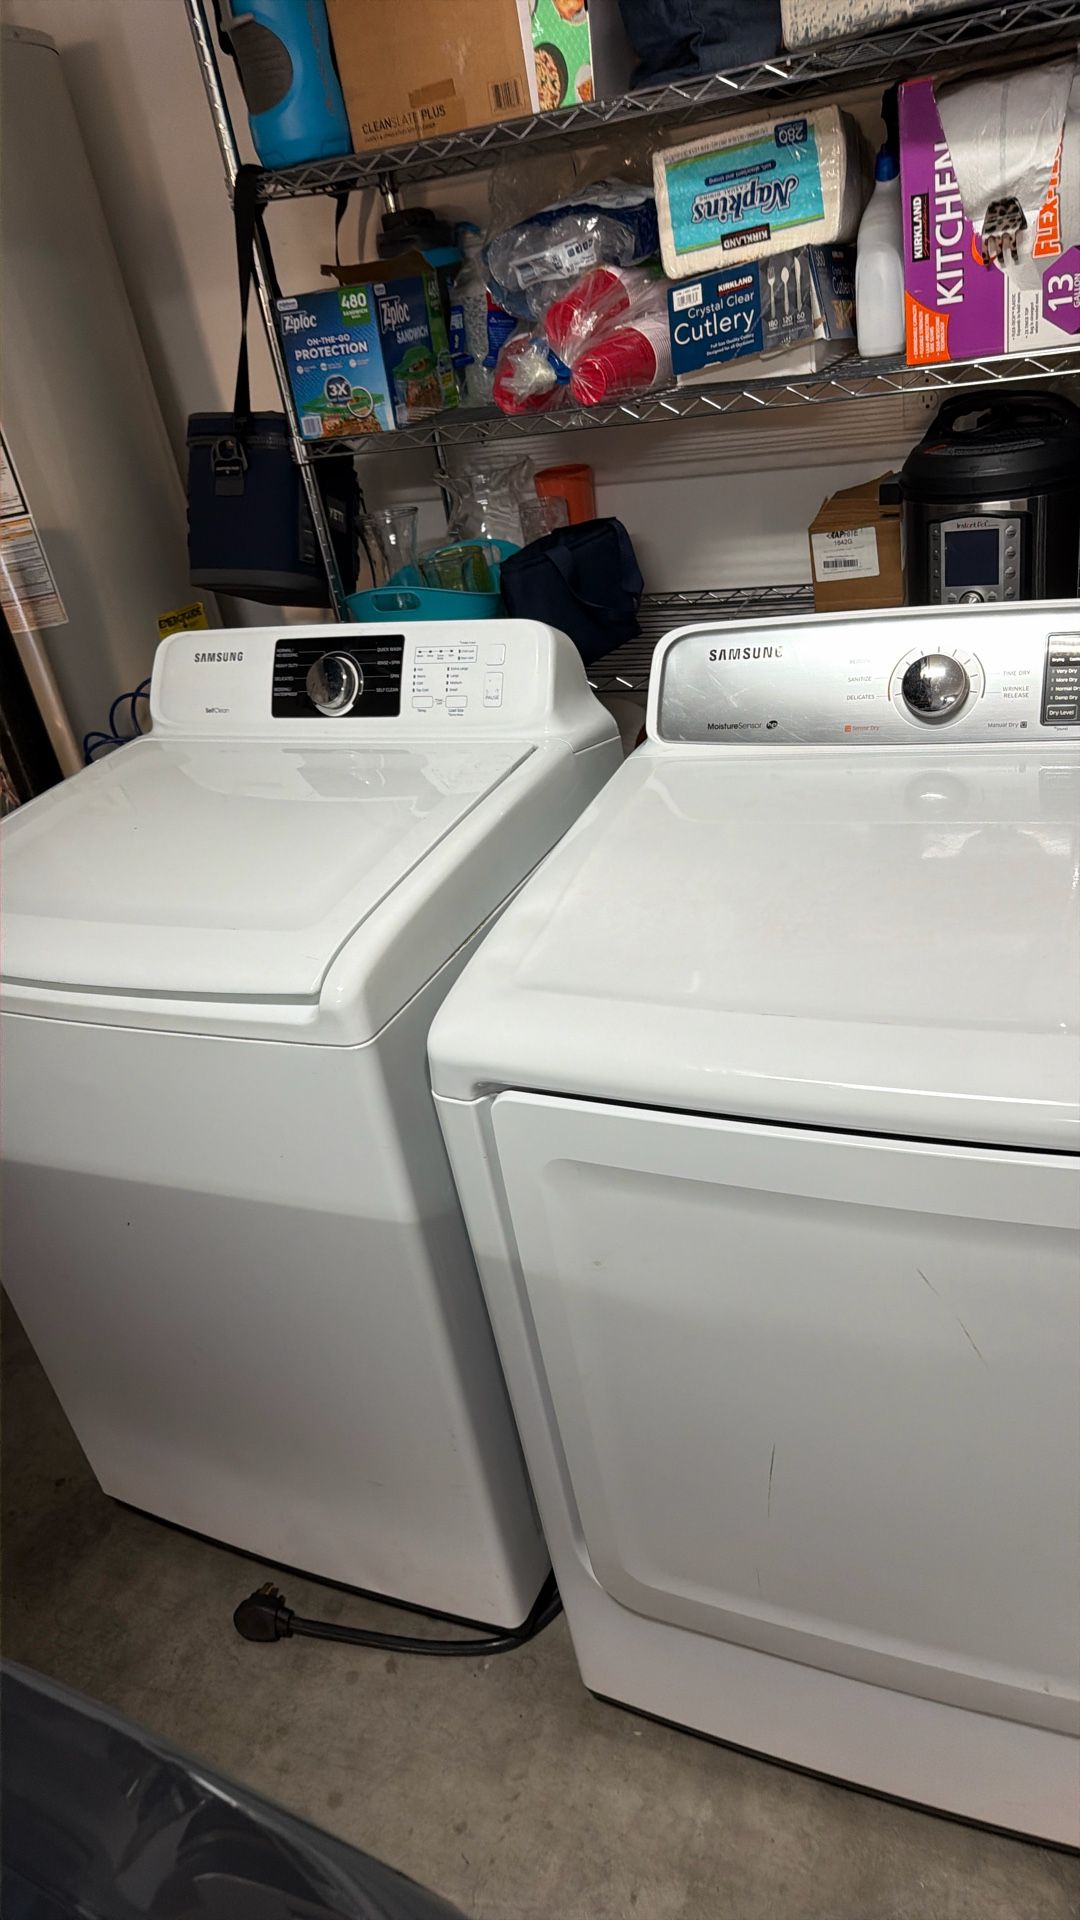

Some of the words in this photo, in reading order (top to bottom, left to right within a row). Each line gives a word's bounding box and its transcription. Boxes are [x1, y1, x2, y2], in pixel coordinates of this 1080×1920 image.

[361, 111, 419, 135] CLEANSLATE
[421, 104, 446, 121] PLUS
[778, 129, 804, 144] 280
[693, 176, 798, 223] Napkins
[912, 196, 923, 260] KIRKLAND
[934, 142, 964, 306] KITCHEN
[724, 230, 769, 249] KIRKLAND
[717, 275, 753, 292] KIRKLAND
[1047, 273, 1074, 312] 13
[341, 293, 367, 309] 480
[688, 298, 724, 319] Crystal
[726, 292, 754, 307] Clear
[283, 313, 318, 334] Ziploc
[381, 300, 411, 332] Ziploc
[767, 319, 778, 328] 180
[782, 314, 793, 324] 120
[796, 311, 805, 320] 60
[396, 325, 429, 344] SANDWICH
[674, 309, 755, 345] Cutlery
[306, 334, 351, 347] ON-THE-GO
[294, 341, 368, 361] PROTECTION
[328, 382, 348, 396] 3X
[194, 651, 244, 663] SAMSUNG
[708, 722, 762, 730] MoistureSensor
